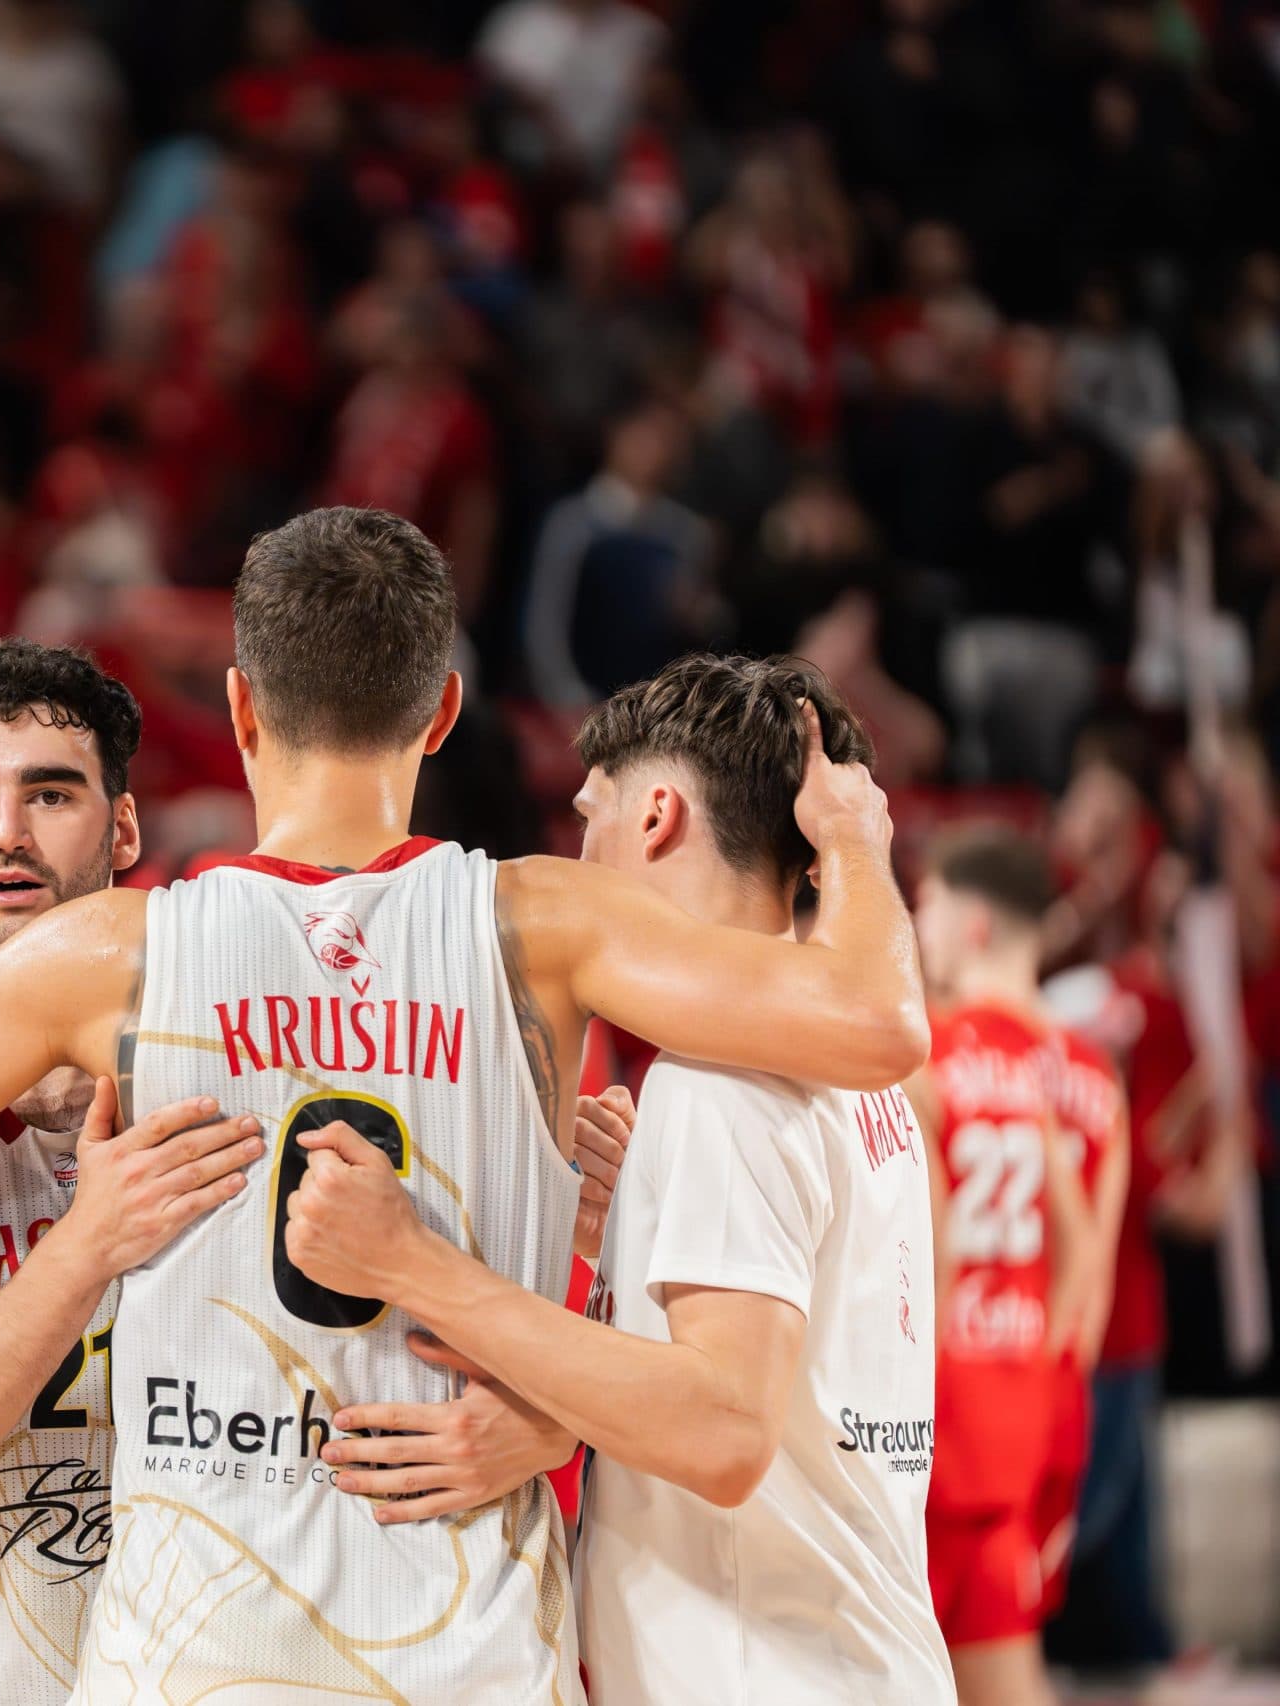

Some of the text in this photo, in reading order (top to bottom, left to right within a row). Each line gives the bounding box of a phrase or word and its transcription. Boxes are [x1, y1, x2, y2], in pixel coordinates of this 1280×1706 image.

[214, 975, 464, 1083] KRUŠLIN
[57, 1180, 78, 1189] ELIT
[147, 1376, 331, 1458] Eberh
[144, 1456, 246, 1480] MARQUE
[265, 1467, 296, 1484] DE
